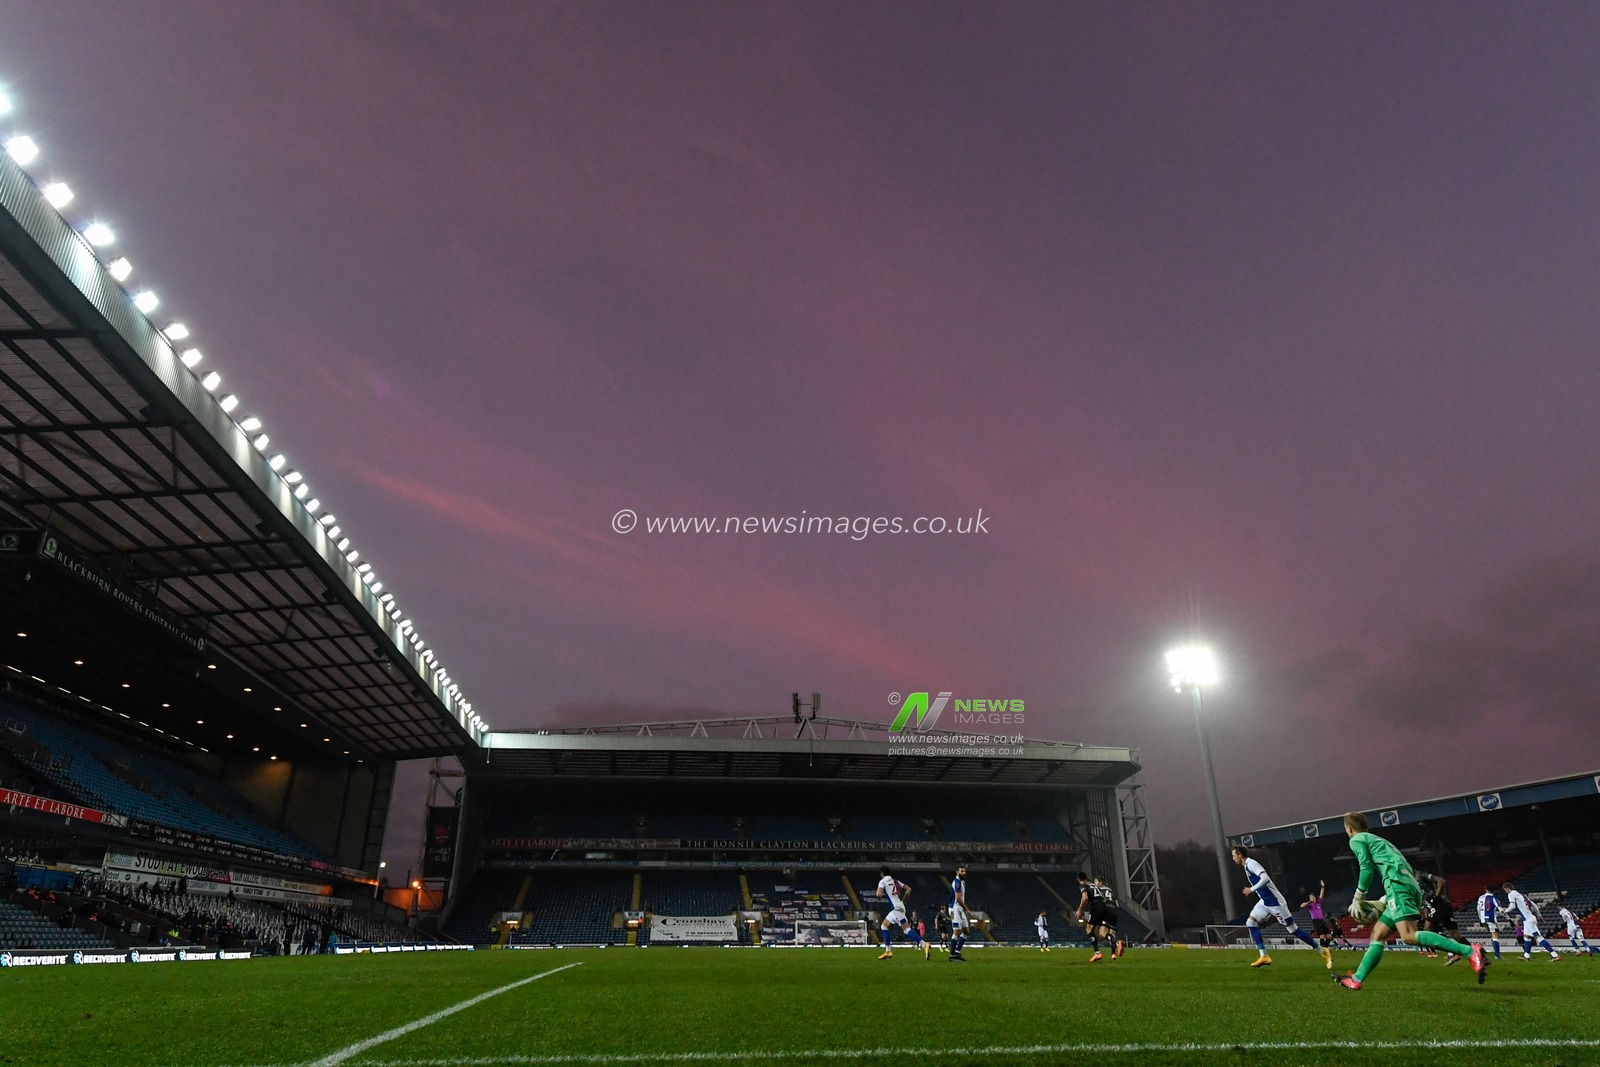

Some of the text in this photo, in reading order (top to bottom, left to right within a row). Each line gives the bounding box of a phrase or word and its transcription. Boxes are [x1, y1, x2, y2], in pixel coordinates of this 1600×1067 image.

[57, 551, 112, 593] BLACKBURN
[113, 588, 144, 613] ROVERS
[3, 792, 84, 819] ARTE ET LABORE
[489, 838, 564, 848] ARTE ET LABORE
[687, 839, 902, 850] THE RONNIE CLAYTON BLACKBURN END
[1014, 843, 1032, 851] ARTE
[1034, 843, 1043, 851] ET
[135, 851, 167, 871] STUDY
[168, 857, 180, 872] AT
[180, 858, 208, 878] EWOOD
[13, 954, 68, 966] RECOVERITE
[83, 953, 127, 964] RECOVERITE
